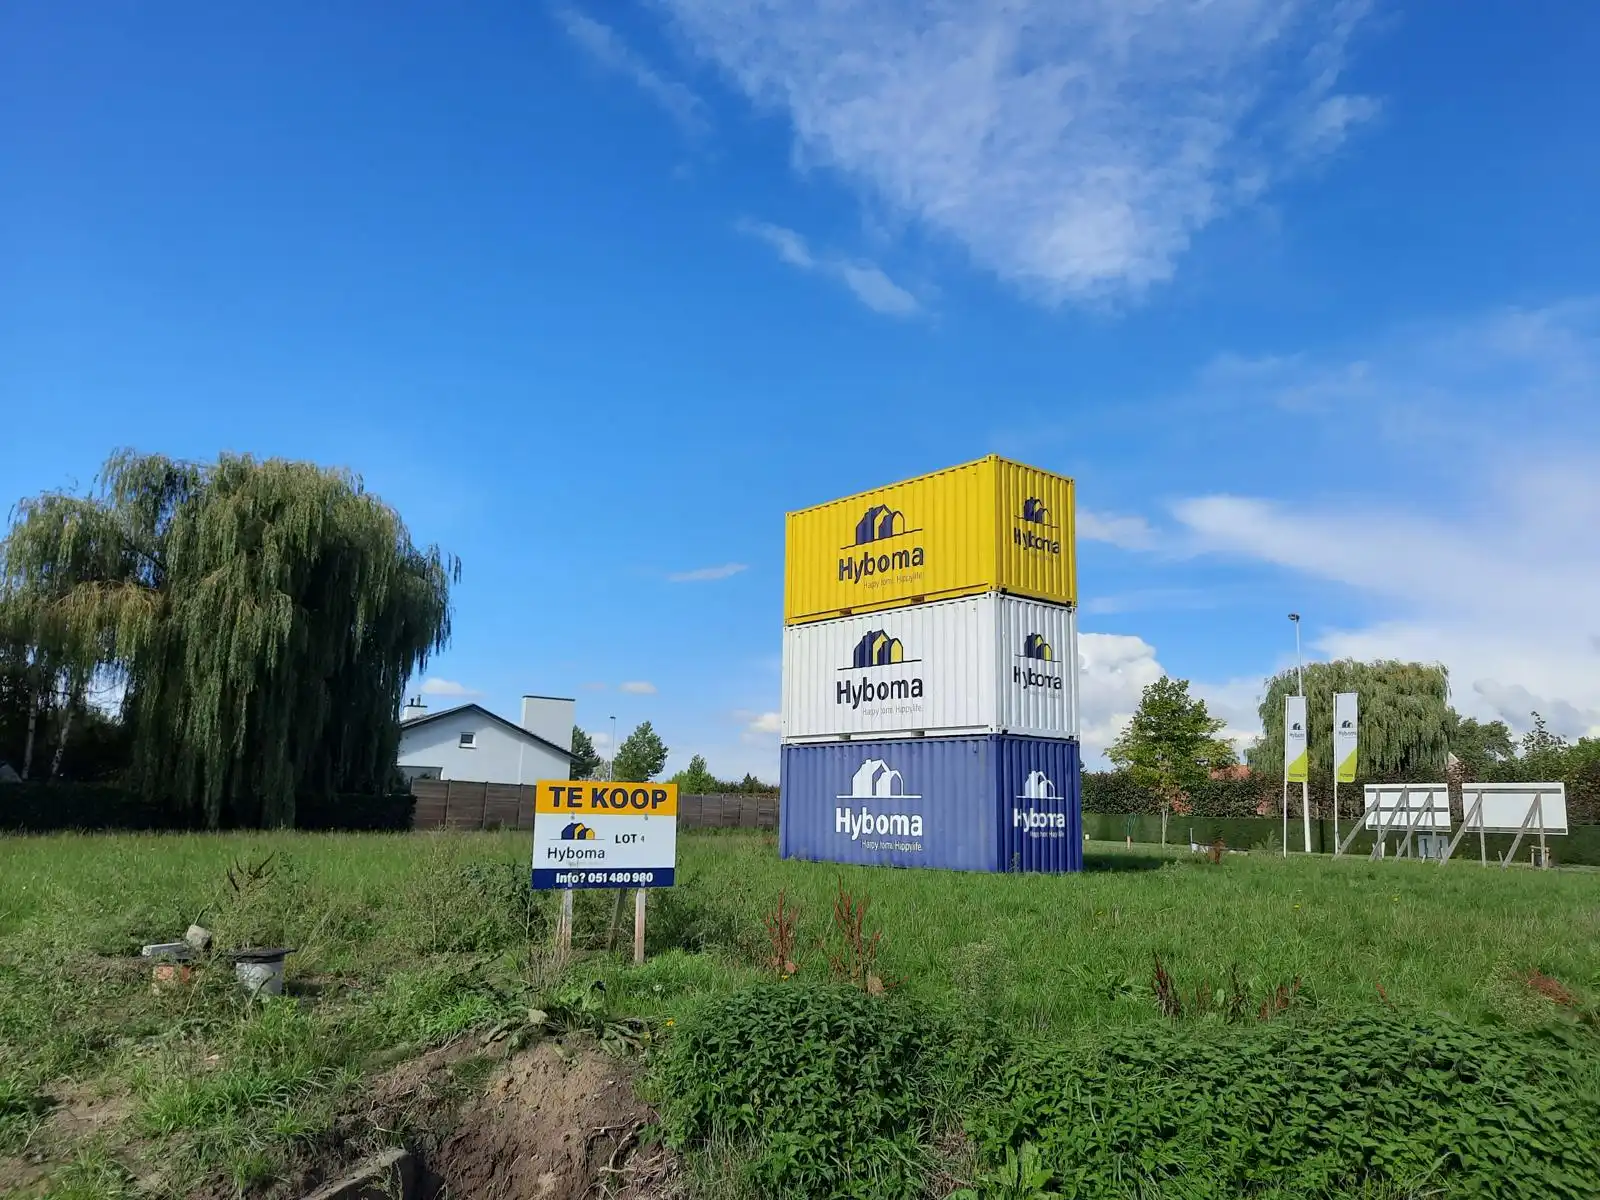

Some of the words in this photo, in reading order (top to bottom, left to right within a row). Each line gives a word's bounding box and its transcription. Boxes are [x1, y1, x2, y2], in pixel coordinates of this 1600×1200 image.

[838, 547, 924, 584] Hyboma
[1013, 666, 1062, 689] Hyboma
[836, 676, 923, 710] Hyboma
[549, 786, 583, 808] TE
[591, 788, 667, 809] KOOP
[835, 806, 923, 840] Hyboma
[1013, 808, 1065, 832] Hyboma
[615, 834, 637, 844] LOT
[547, 847, 605, 862] Hyboma
[556, 872, 586, 884] Info?
[588, 872, 607, 883] 051
[609, 872, 631, 883] 480
[632, 872, 653, 883] 980
